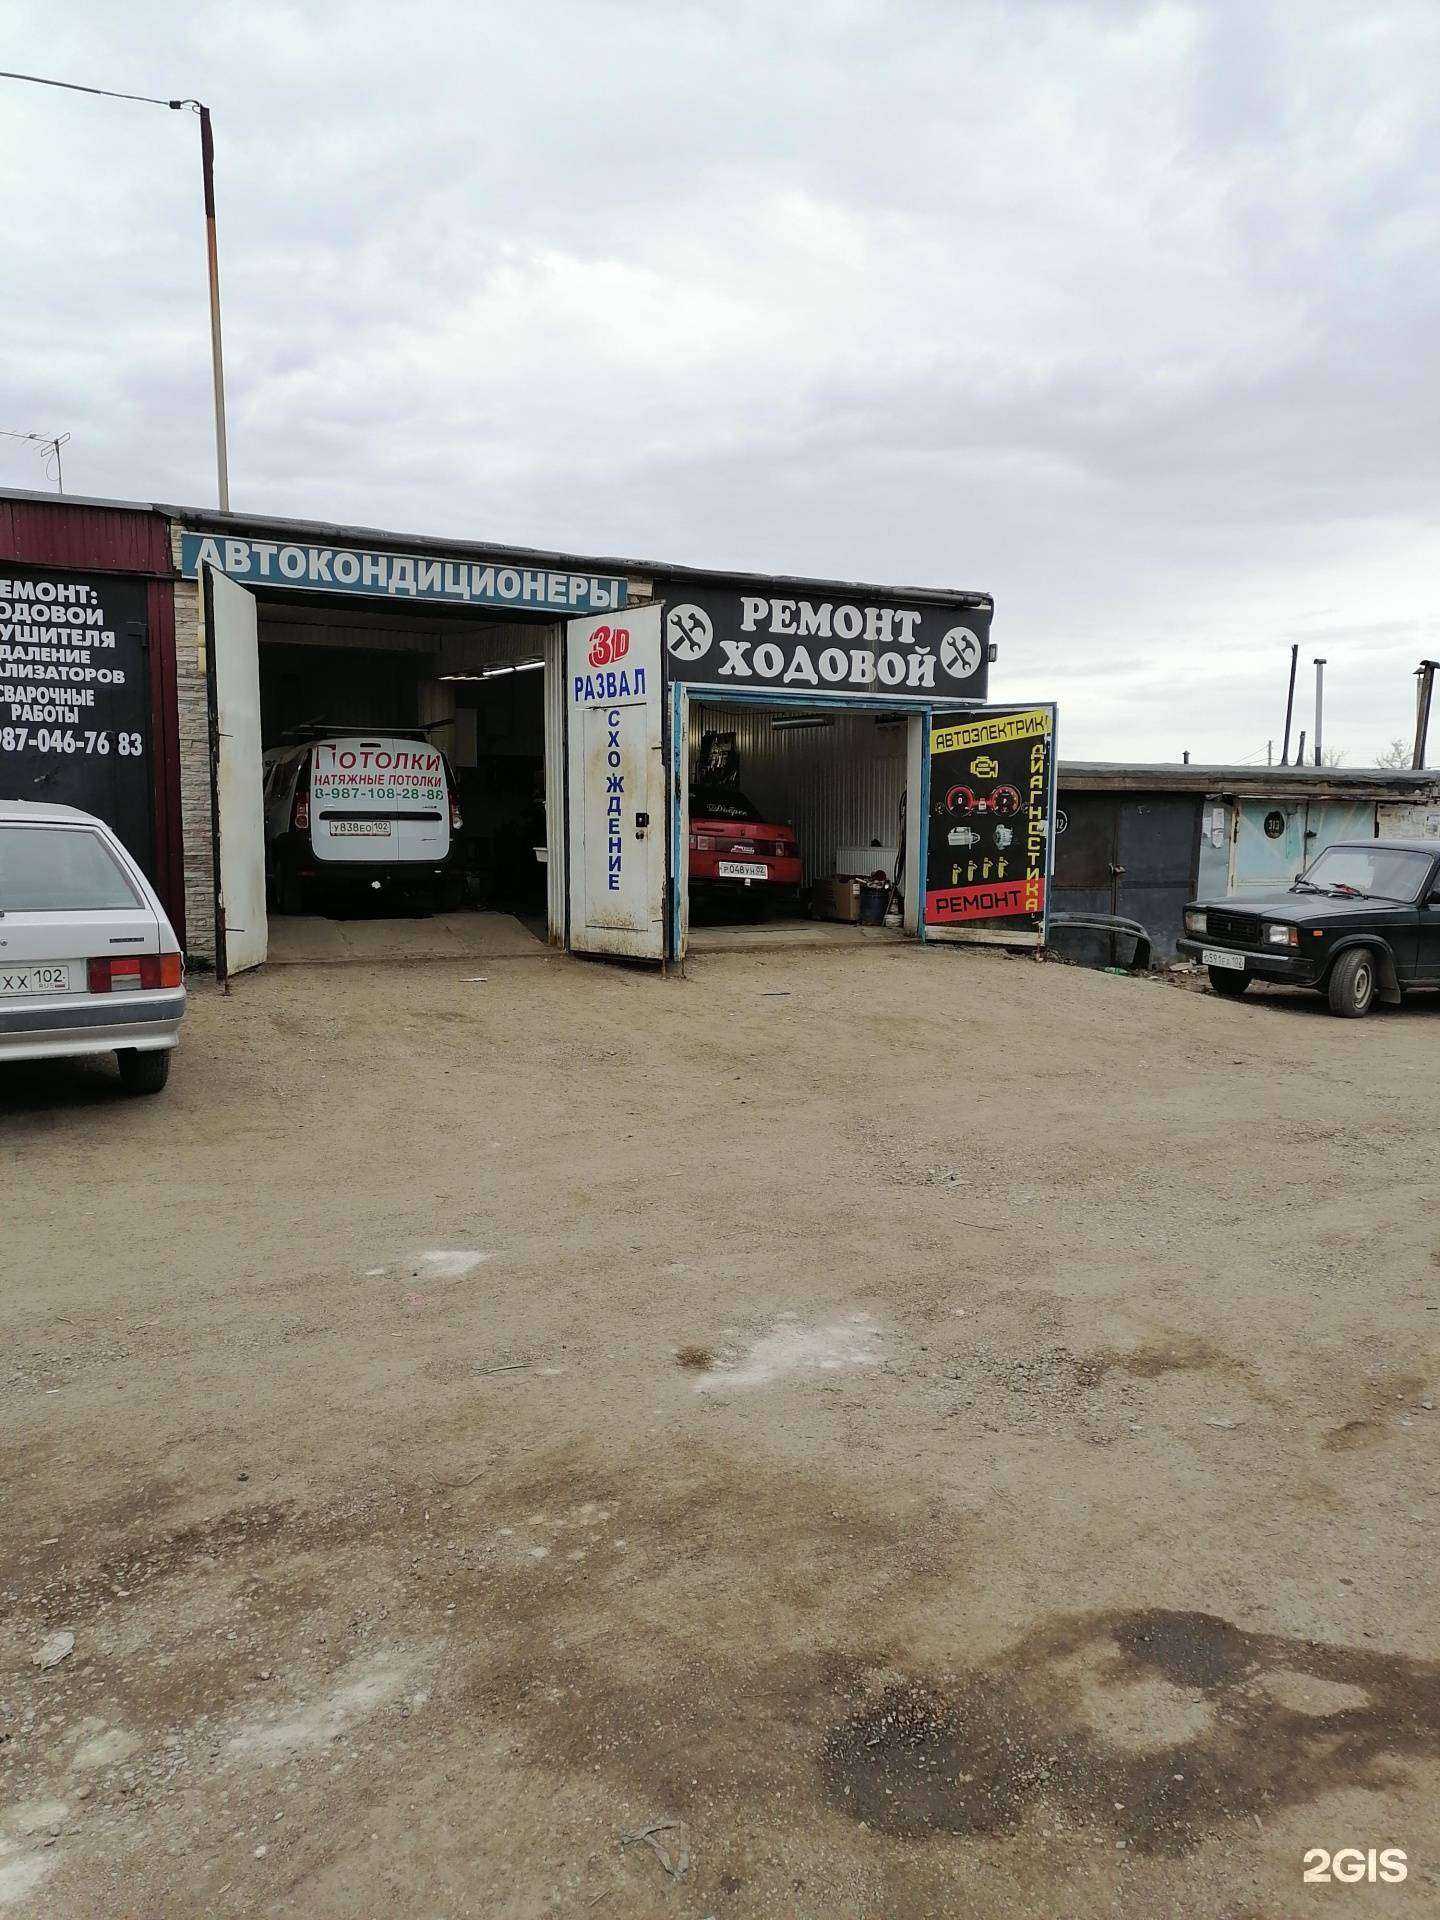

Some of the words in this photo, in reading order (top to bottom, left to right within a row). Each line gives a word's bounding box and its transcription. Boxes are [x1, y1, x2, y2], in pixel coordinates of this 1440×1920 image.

[195, 538, 619, 608] АВТОКОНДИЦИОНЕРЫ
[740, 596, 922, 643] РЕМОНТ
[588, 625, 630, 668] 3D
[717, 640, 937, 687] ХОДОВОЙ
[0, 663, 126, 684] ЛИЗАТОРОВ
[574, 668, 646, 702] РАЗВАЛ
[11, 703, 79, 723] РАБОТЫ
[0, 726, 110, 755] 87-046-76
[118, 732, 143, 756] 83
[314, 774, 384, 786] НАТЯЖНЫЕ
[388, 775, 442, 787] ПОТОЛКИ
[605, 709, 624, 891] СХОЖДЕНИЕ
[1023, 744, 1044, 912] ДИАГНОСТИКА
[936, 890, 1021, 914] РЕМОНТ
[33, 969, 62, 983] 102
